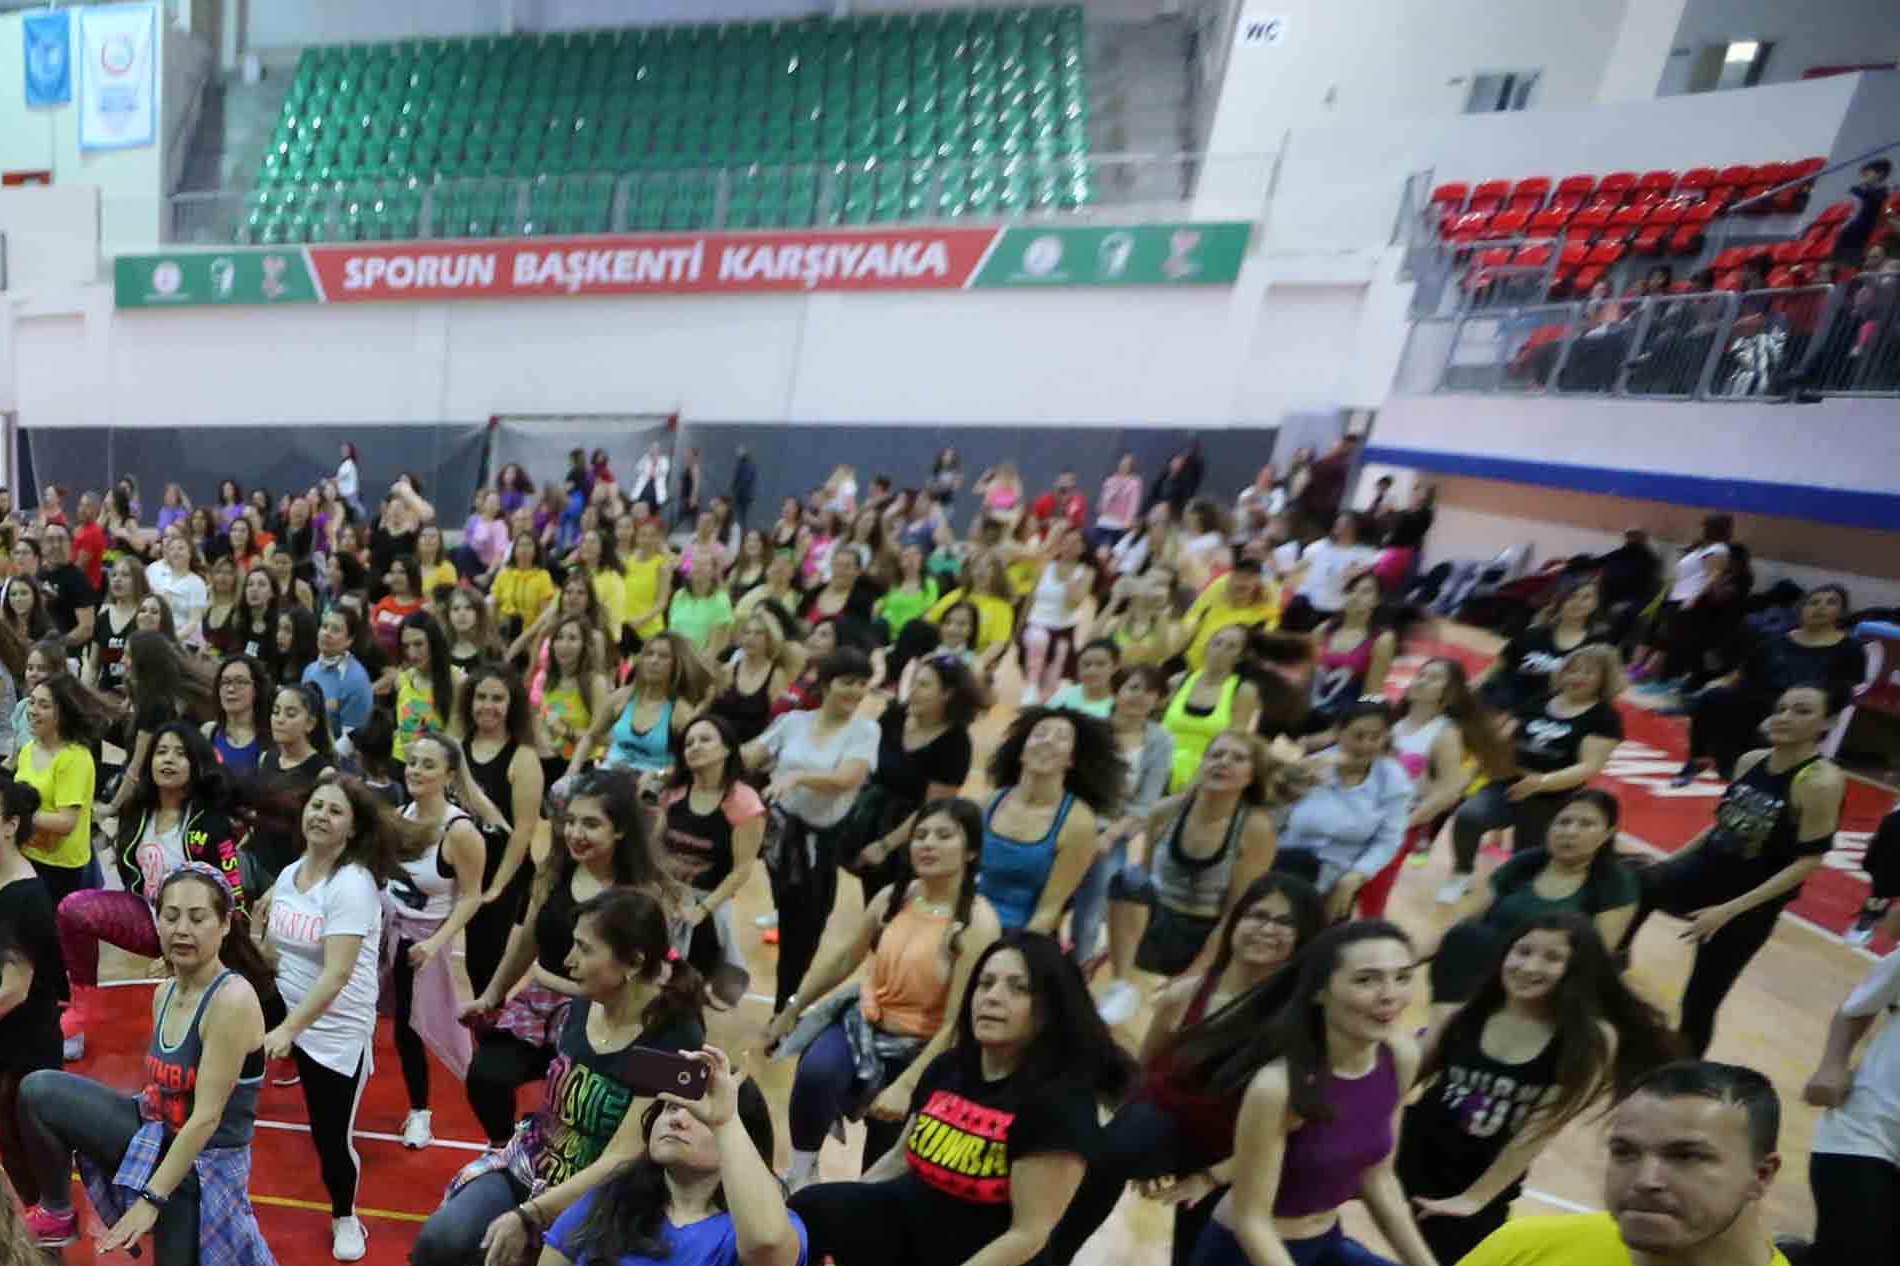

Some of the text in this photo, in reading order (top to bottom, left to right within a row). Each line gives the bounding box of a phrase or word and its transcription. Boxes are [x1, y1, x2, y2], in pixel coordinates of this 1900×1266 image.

[1245, 20, 1280, 41] WC
[343, 240, 947, 293] SPORUN BAŞKENTİ KARŞIYAKA
[907, 1113, 1010, 1177] ZUMBA
